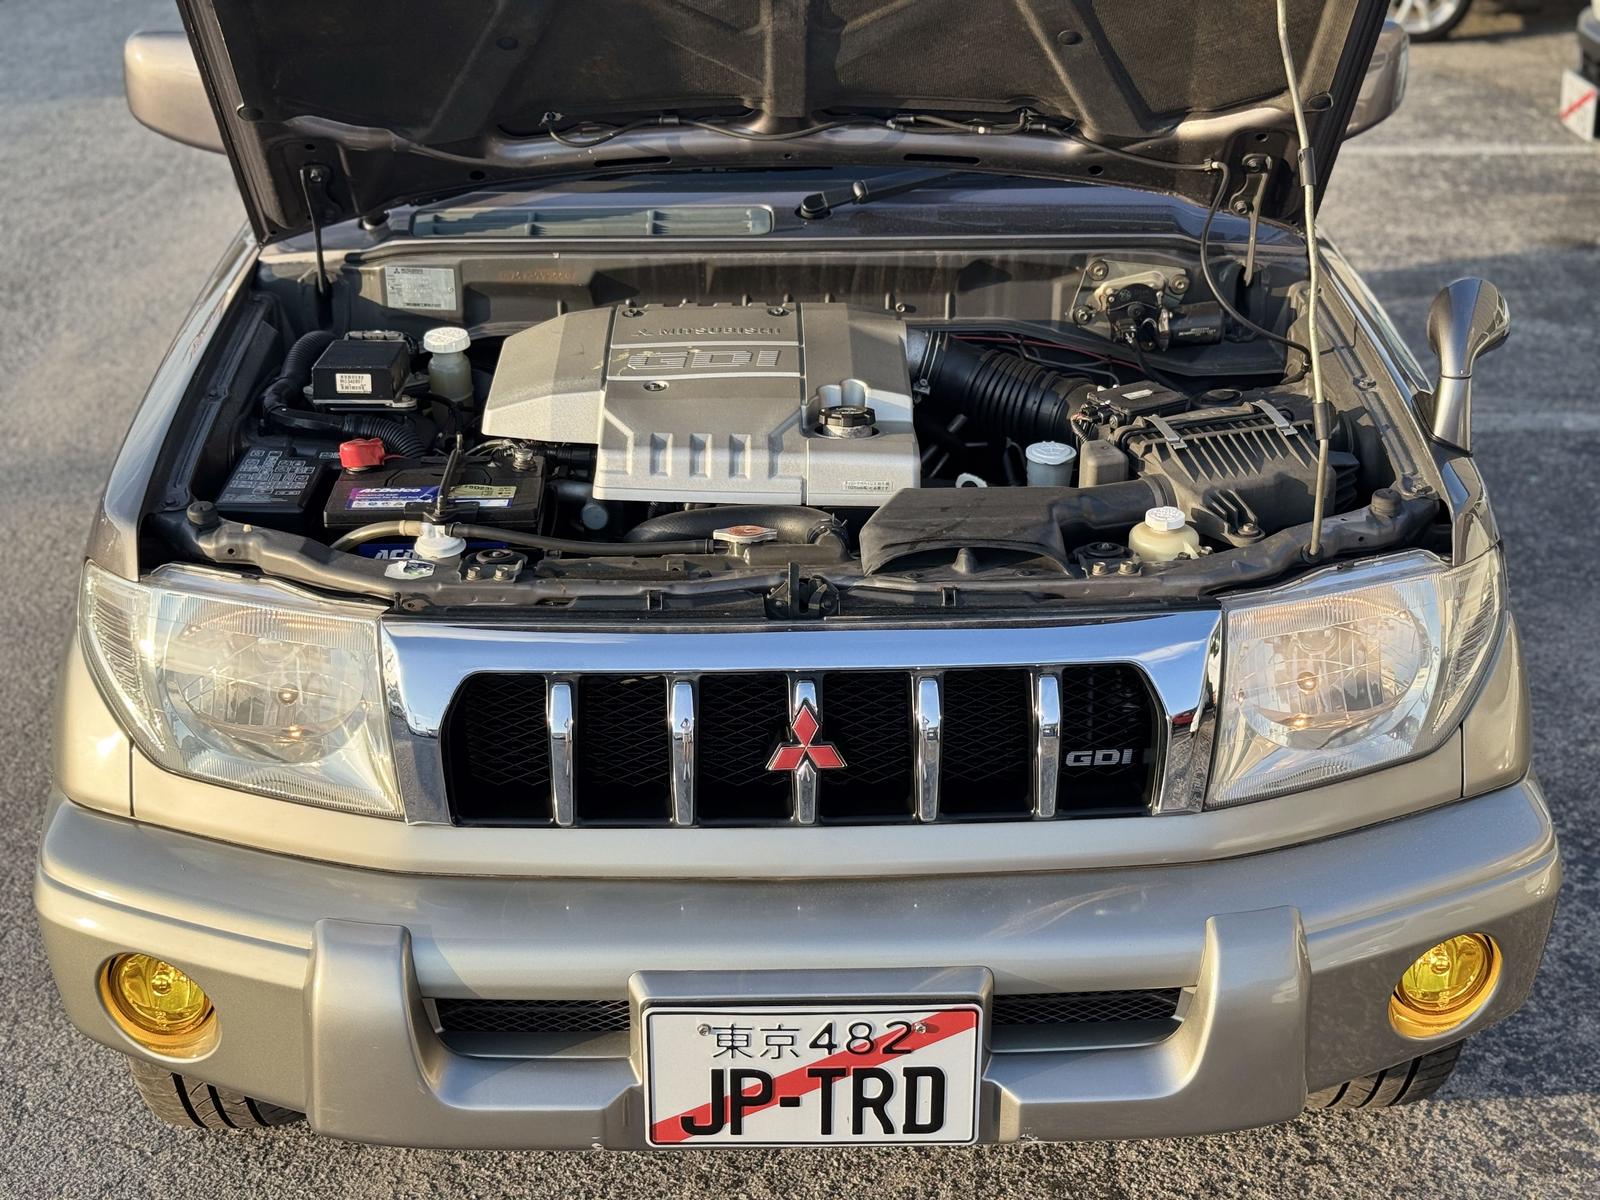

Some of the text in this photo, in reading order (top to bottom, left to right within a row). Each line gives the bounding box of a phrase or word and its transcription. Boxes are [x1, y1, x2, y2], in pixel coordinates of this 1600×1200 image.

[659, 327, 781, 336] MITSUBISHI
[627, 350, 781, 370] GDI
[1065, 749, 1133, 767] GDI
[712, 1022, 914, 1060] 東京 482
[680, 1066, 946, 1136] JP-TRD
